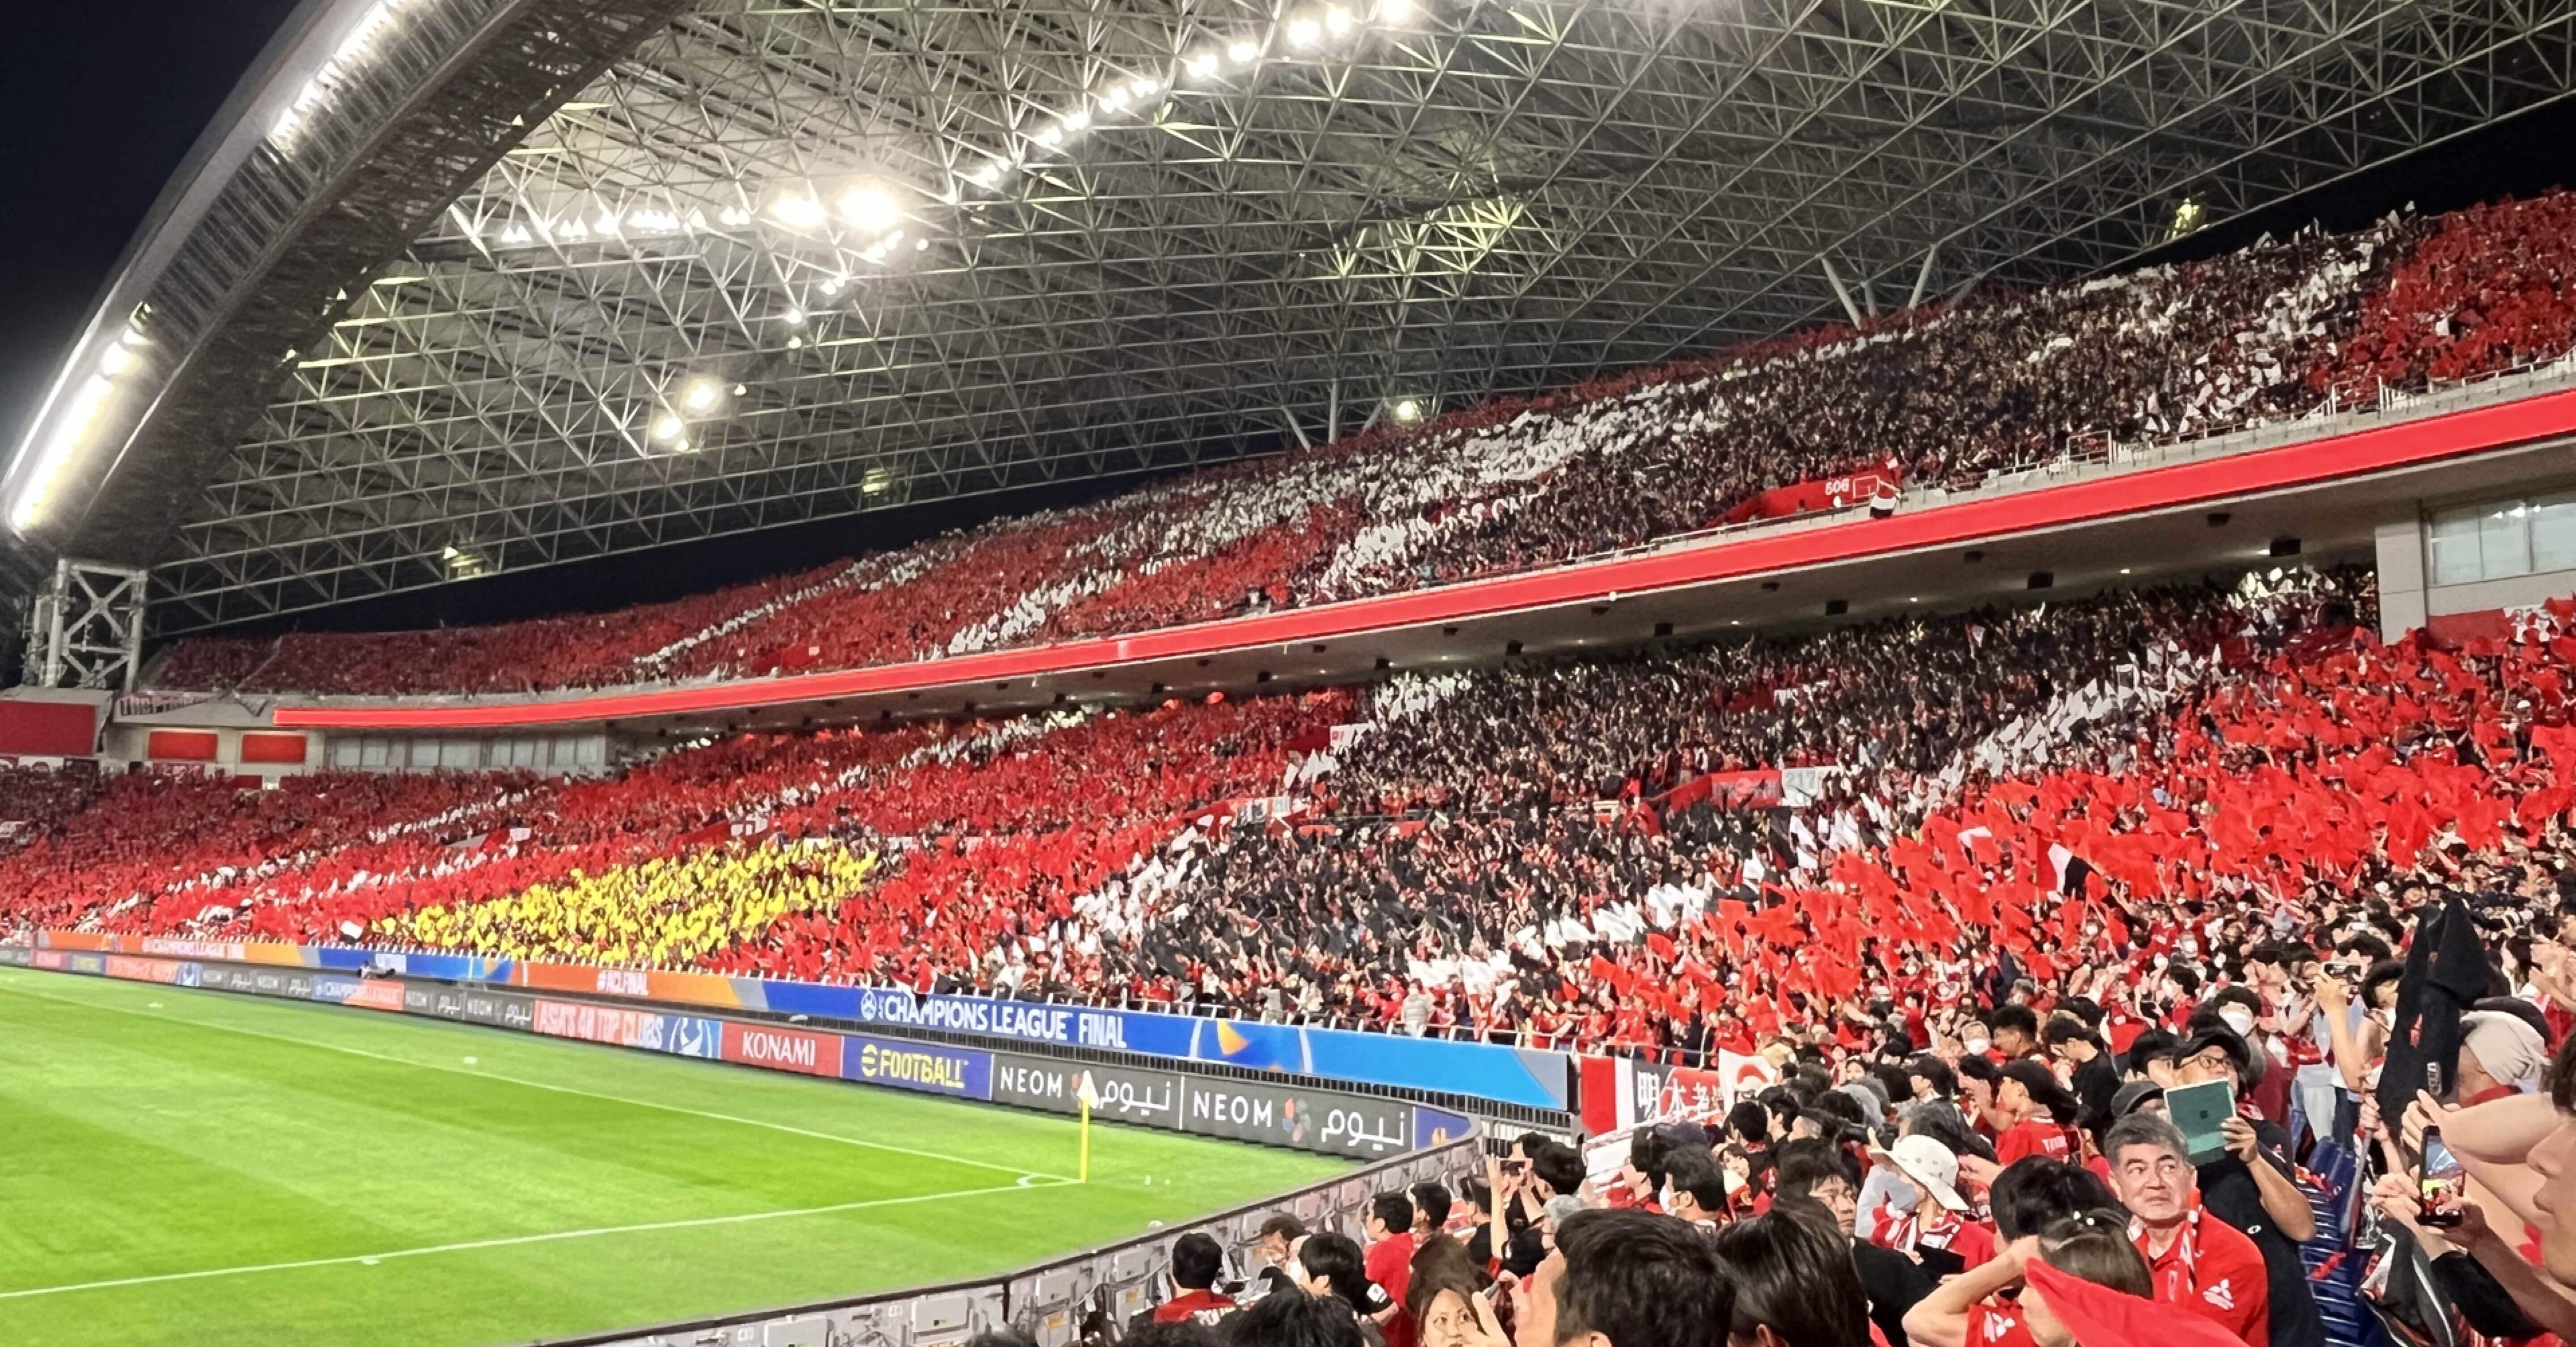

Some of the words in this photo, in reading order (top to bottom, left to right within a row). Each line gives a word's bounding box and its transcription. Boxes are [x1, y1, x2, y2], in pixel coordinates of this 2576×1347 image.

[1785, 771, 1816, 789] 217
[885, 994, 988, 1031] CHAMPIONS
[1078, 1012, 1127, 1048] FINAL
[742, 1031, 816, 1066] KONAMI
[1000, 1066, 1062, 1098] NEOM
[1193, 1090, 1272, 1127] NEOM
